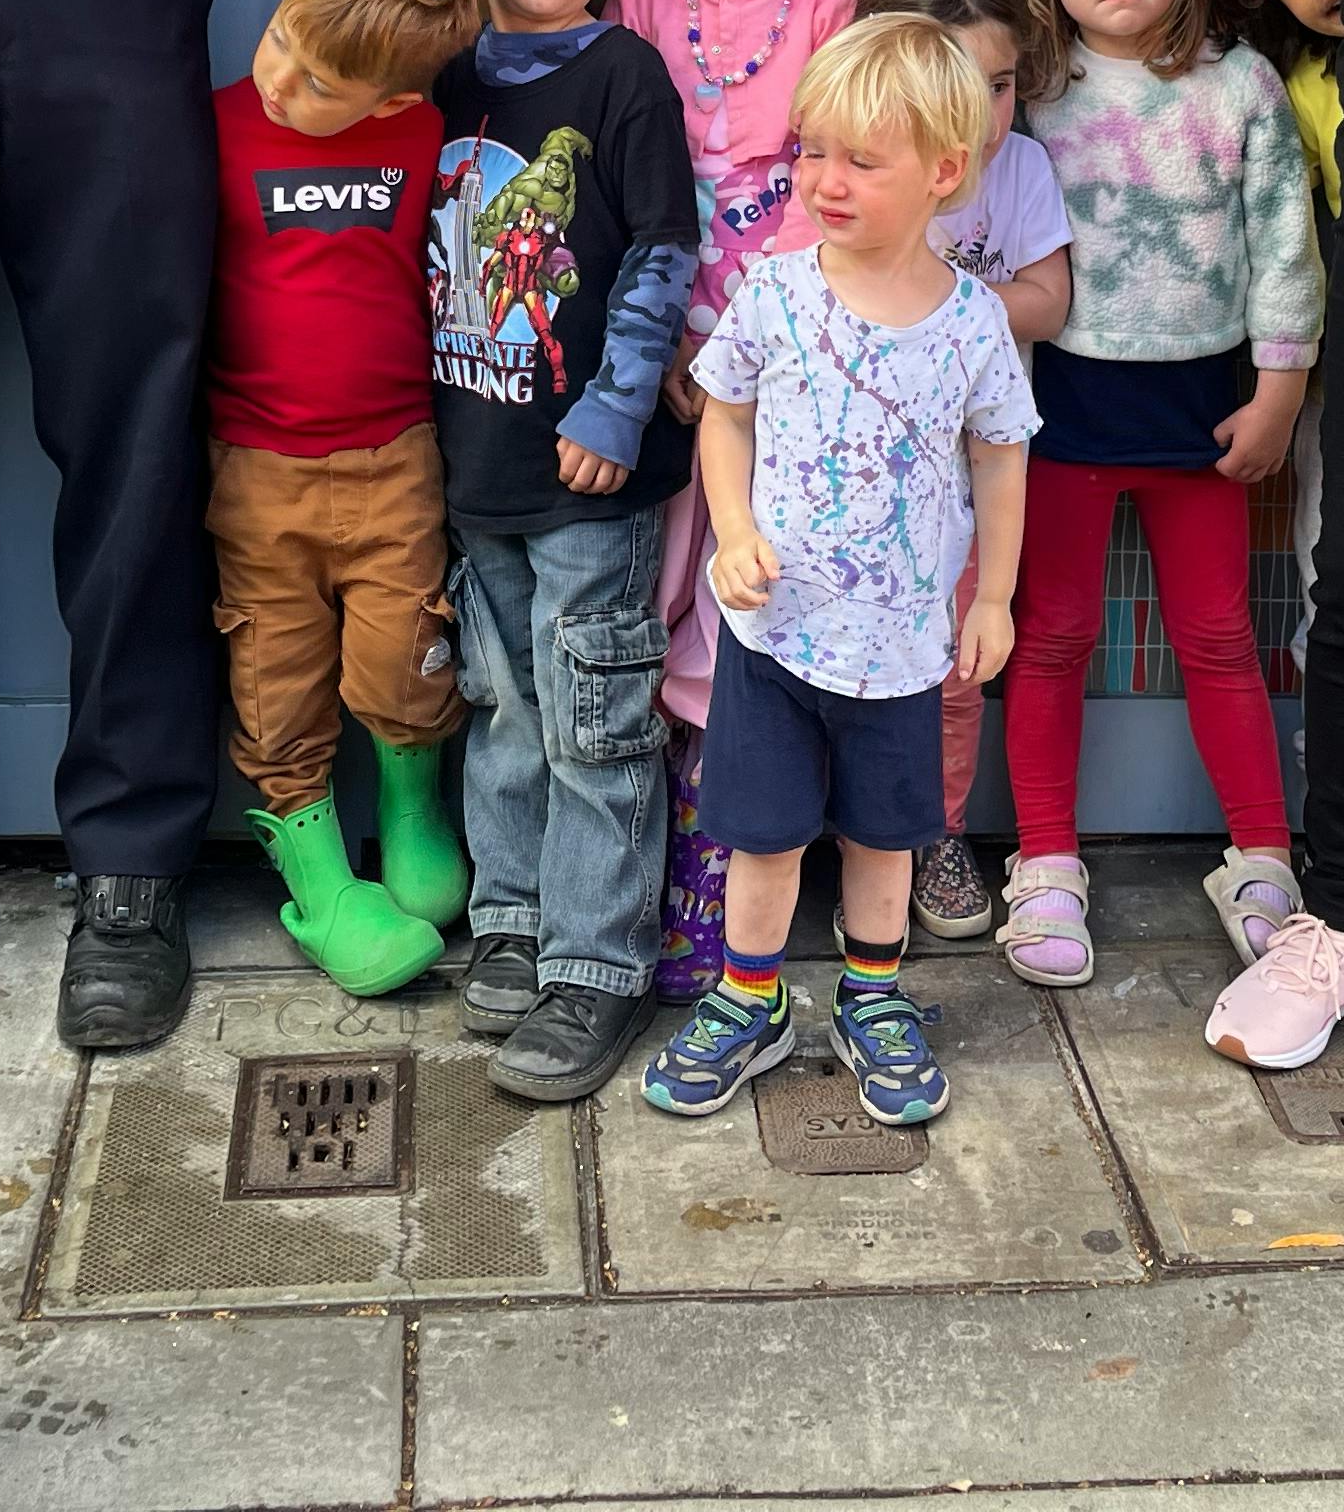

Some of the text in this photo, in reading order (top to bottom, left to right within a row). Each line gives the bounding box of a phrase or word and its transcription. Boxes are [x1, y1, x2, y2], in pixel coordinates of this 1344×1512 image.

[721, 177, 792, 237] pepp
[433, 353, 534, 405] UILDING
[483, 337, 536, 369] SATE
